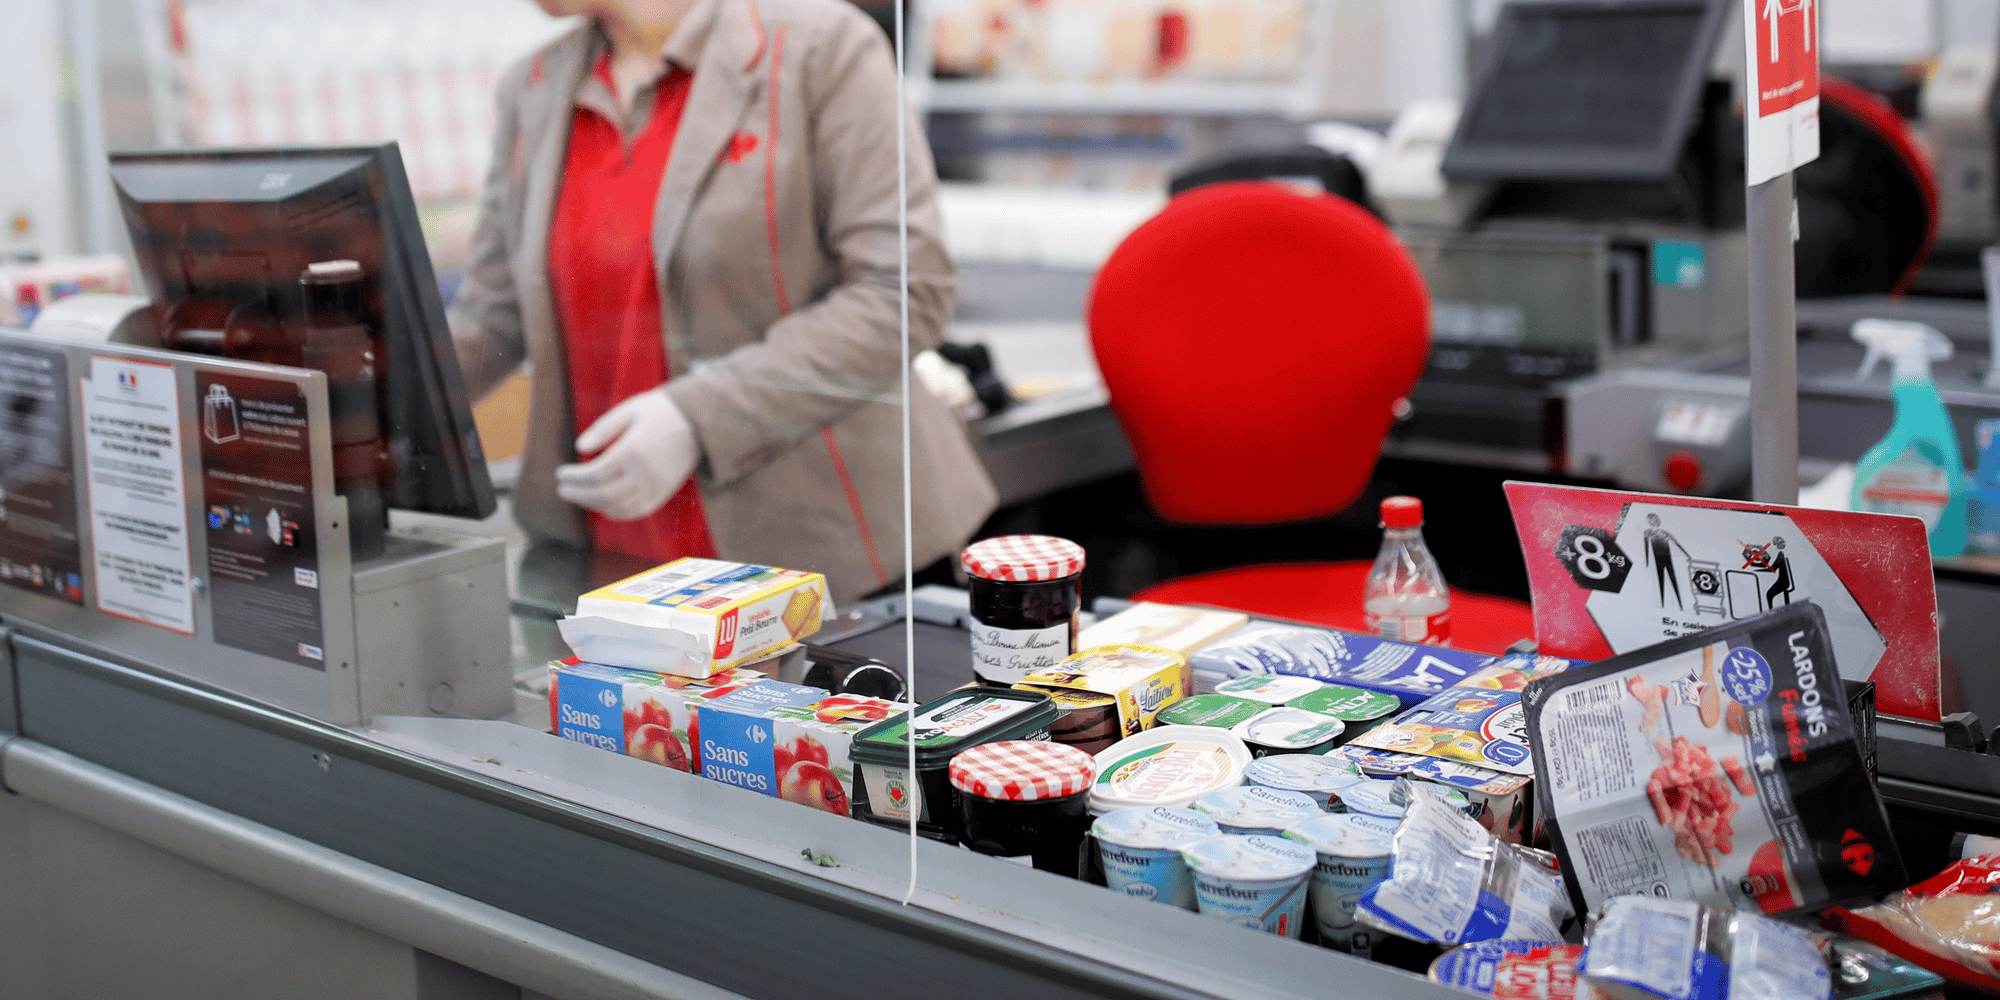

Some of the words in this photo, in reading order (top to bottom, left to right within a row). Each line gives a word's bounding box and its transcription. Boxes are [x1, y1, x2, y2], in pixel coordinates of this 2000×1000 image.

[720, 615, 737, 645] LU
[1662, 616, 1679, 627] En
[1788, 630, 1828, 738] LARDONS
[562, 703, 602, 730] Sans
[1778, 687, 1810, 764] Fumés
[562, 727, 618, 752] sucres
[704, 739, 750, 768] Sans
[706, 763, 769, 791] sucres
[1249, 786, 1313, 809] Carrefour
[1153, 806, 1213, 829] Carrefour
[1350, 815, 1398, 835] Carref
[1247, 835, 1312, 860] Carrefour
[1198, 882, 1259, 900] arrefour
